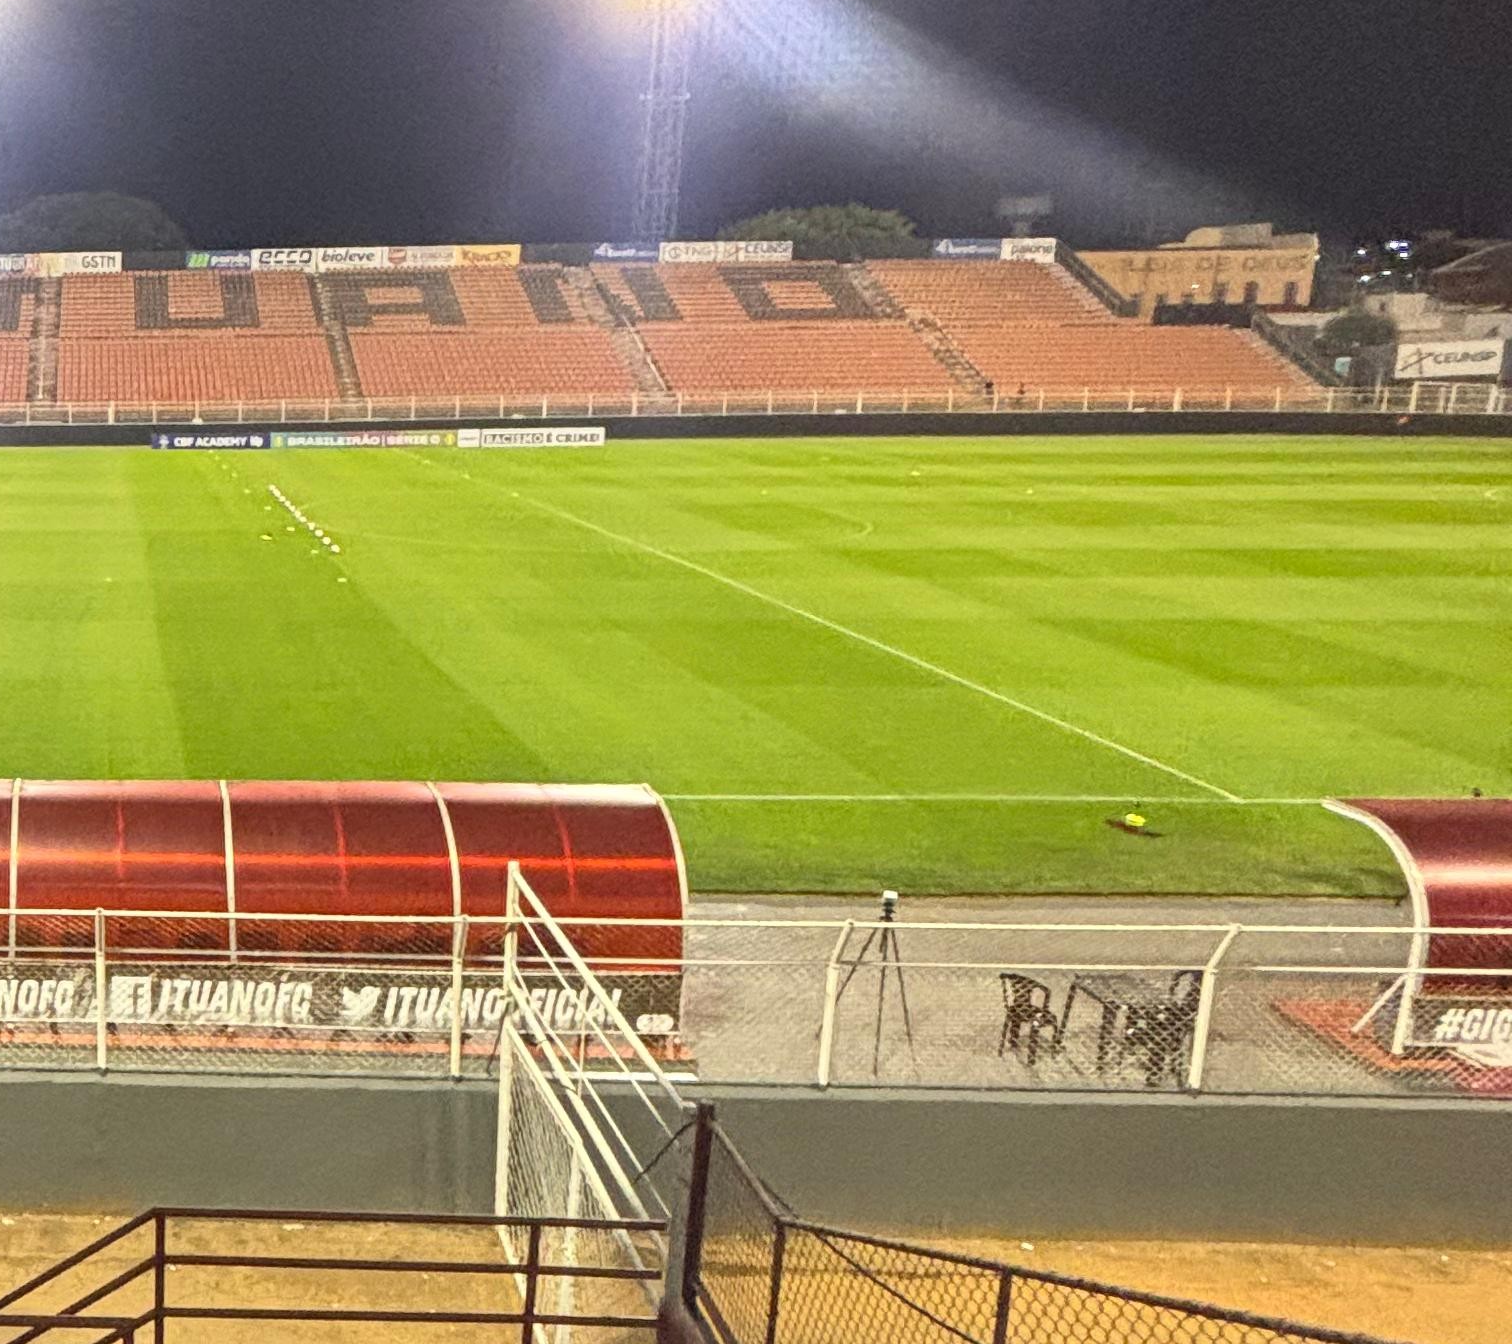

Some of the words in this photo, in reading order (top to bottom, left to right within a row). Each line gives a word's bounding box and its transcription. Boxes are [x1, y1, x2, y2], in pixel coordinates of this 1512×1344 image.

[321, 250, 376, 263] bioleve
[195, 436, 248, 447] ACADEMY
[484, 433, 543, 444] RACISMO
[157, 978, 313, 1022] ITUANOFC
